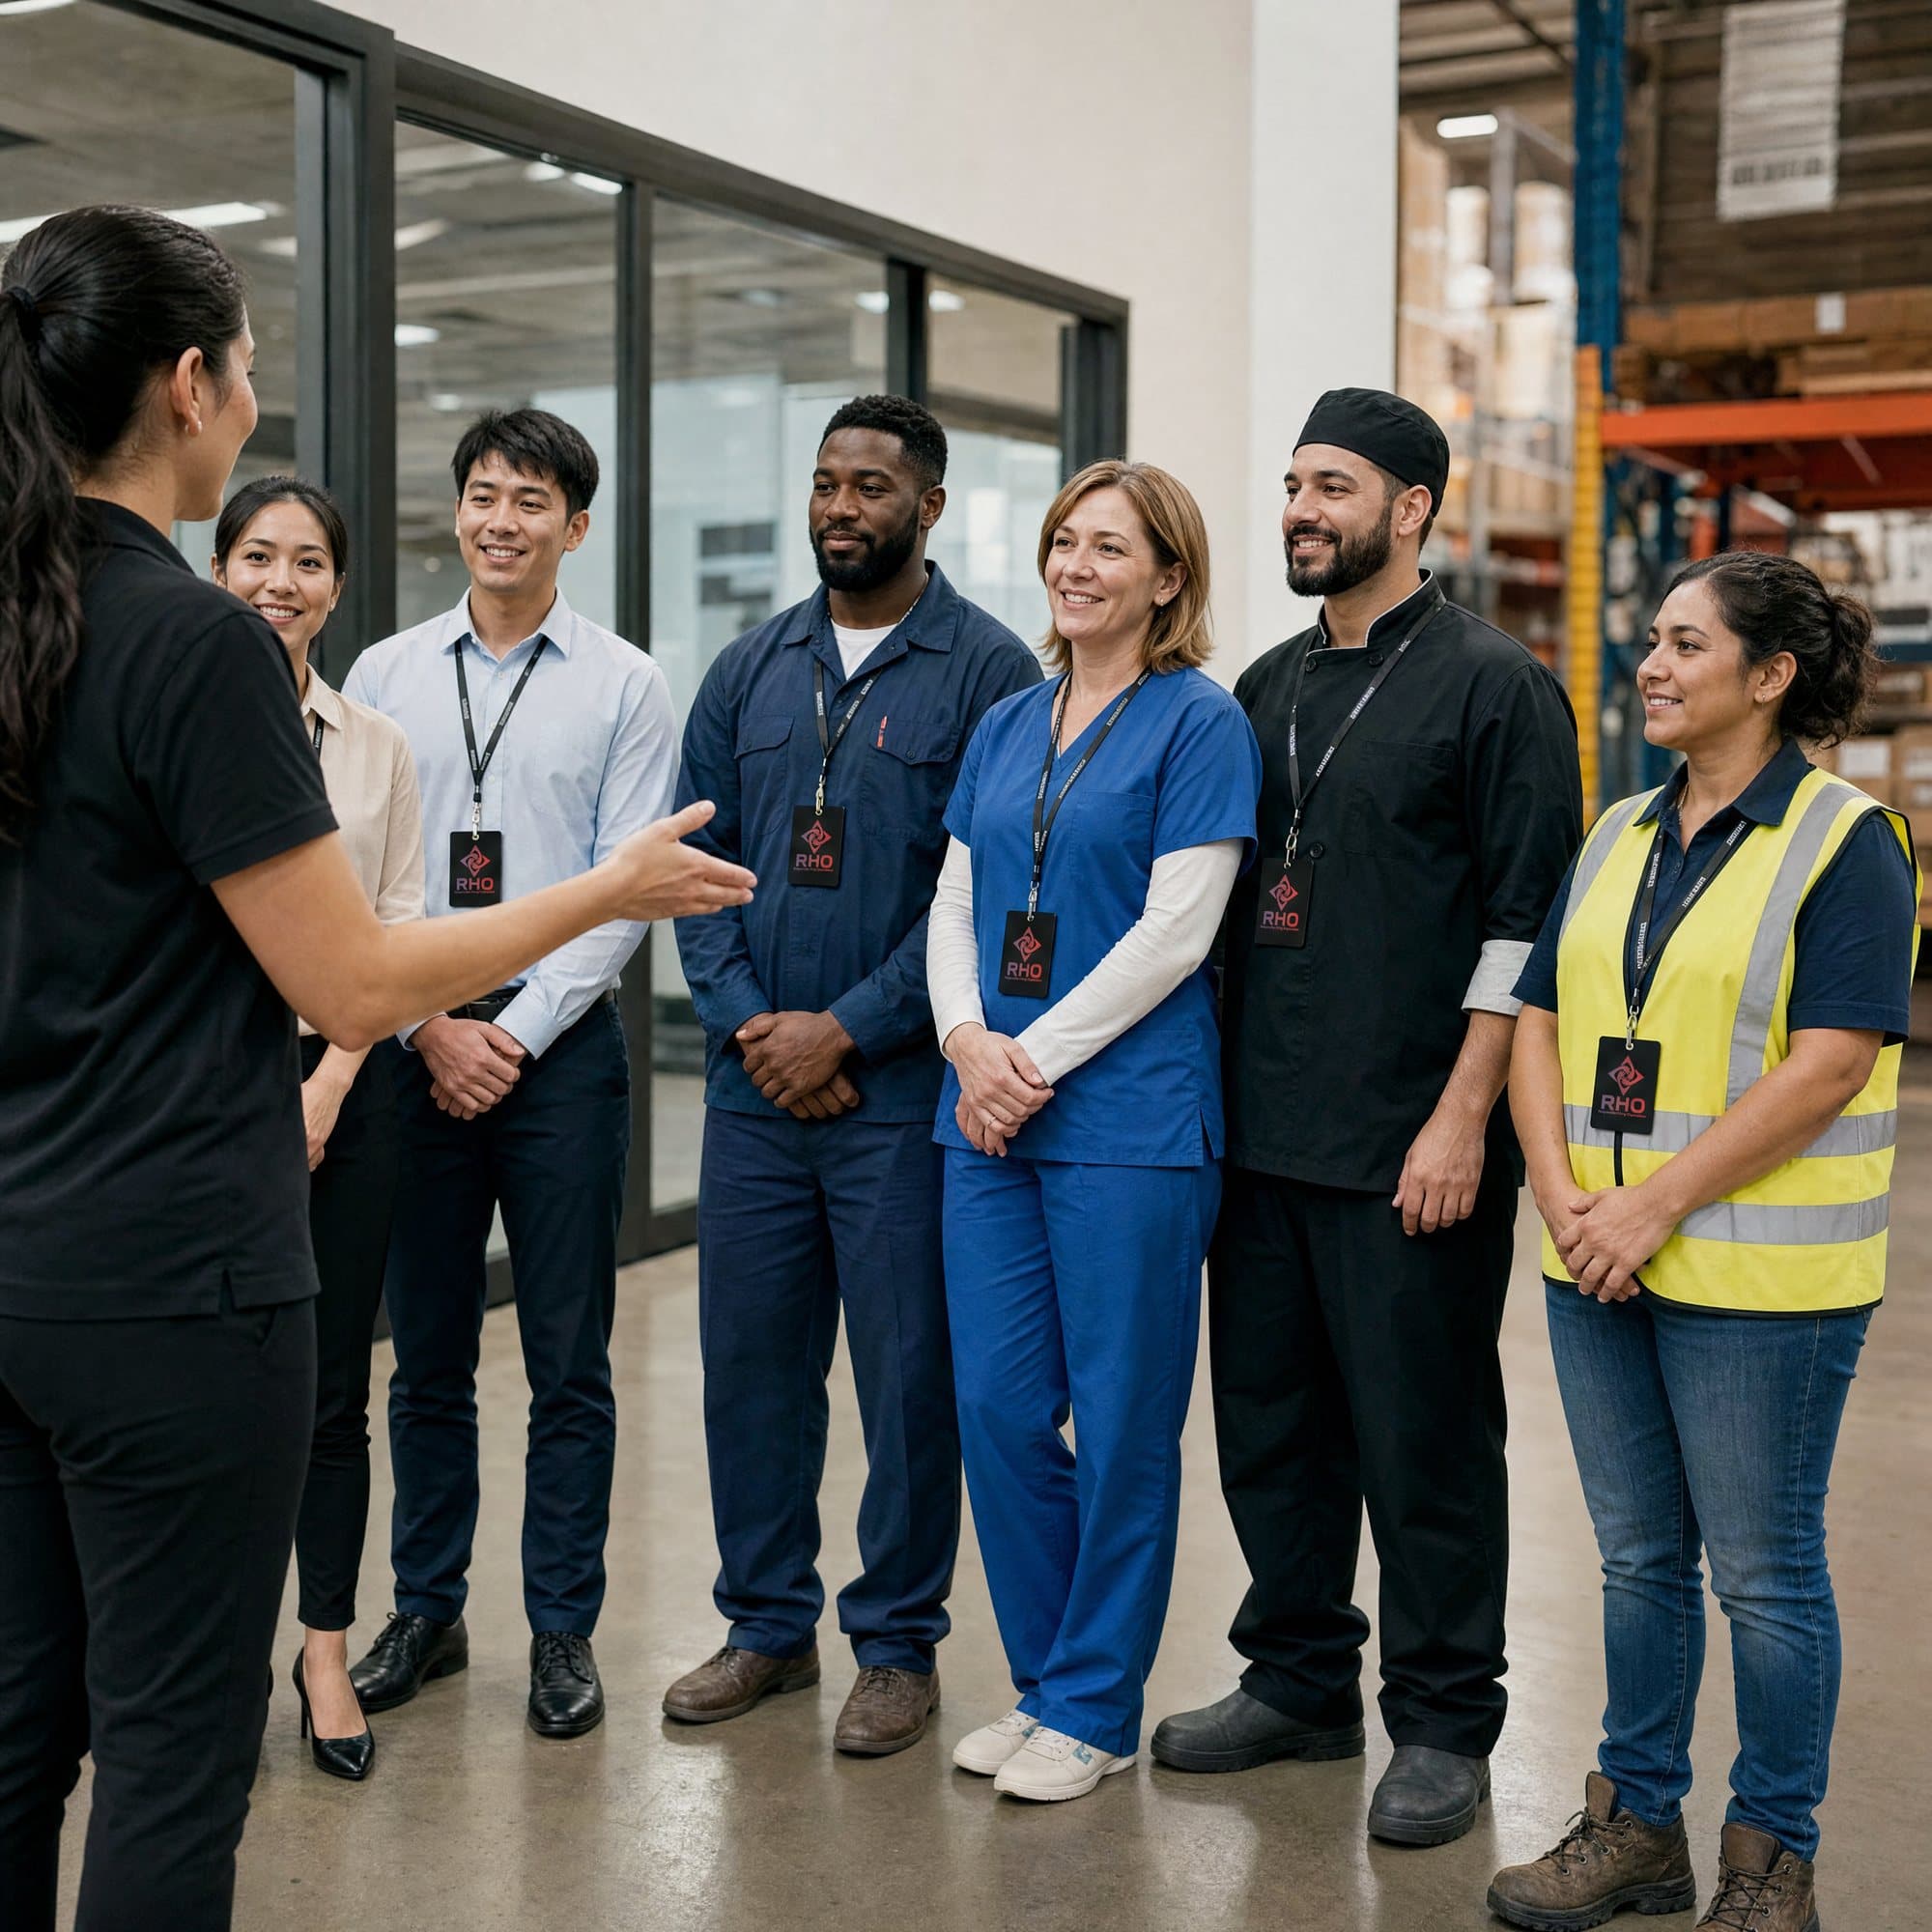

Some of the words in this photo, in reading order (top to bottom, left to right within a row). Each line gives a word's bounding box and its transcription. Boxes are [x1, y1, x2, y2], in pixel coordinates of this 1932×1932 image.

[795, 854, 834, 868] RHO
[456, 877, 495, 891] RHO
[1263, 911, 1299, 927] RHO
[1007, 961, 1042, 979] RHO
[1601, 1094, 1646, 1114] RHO
